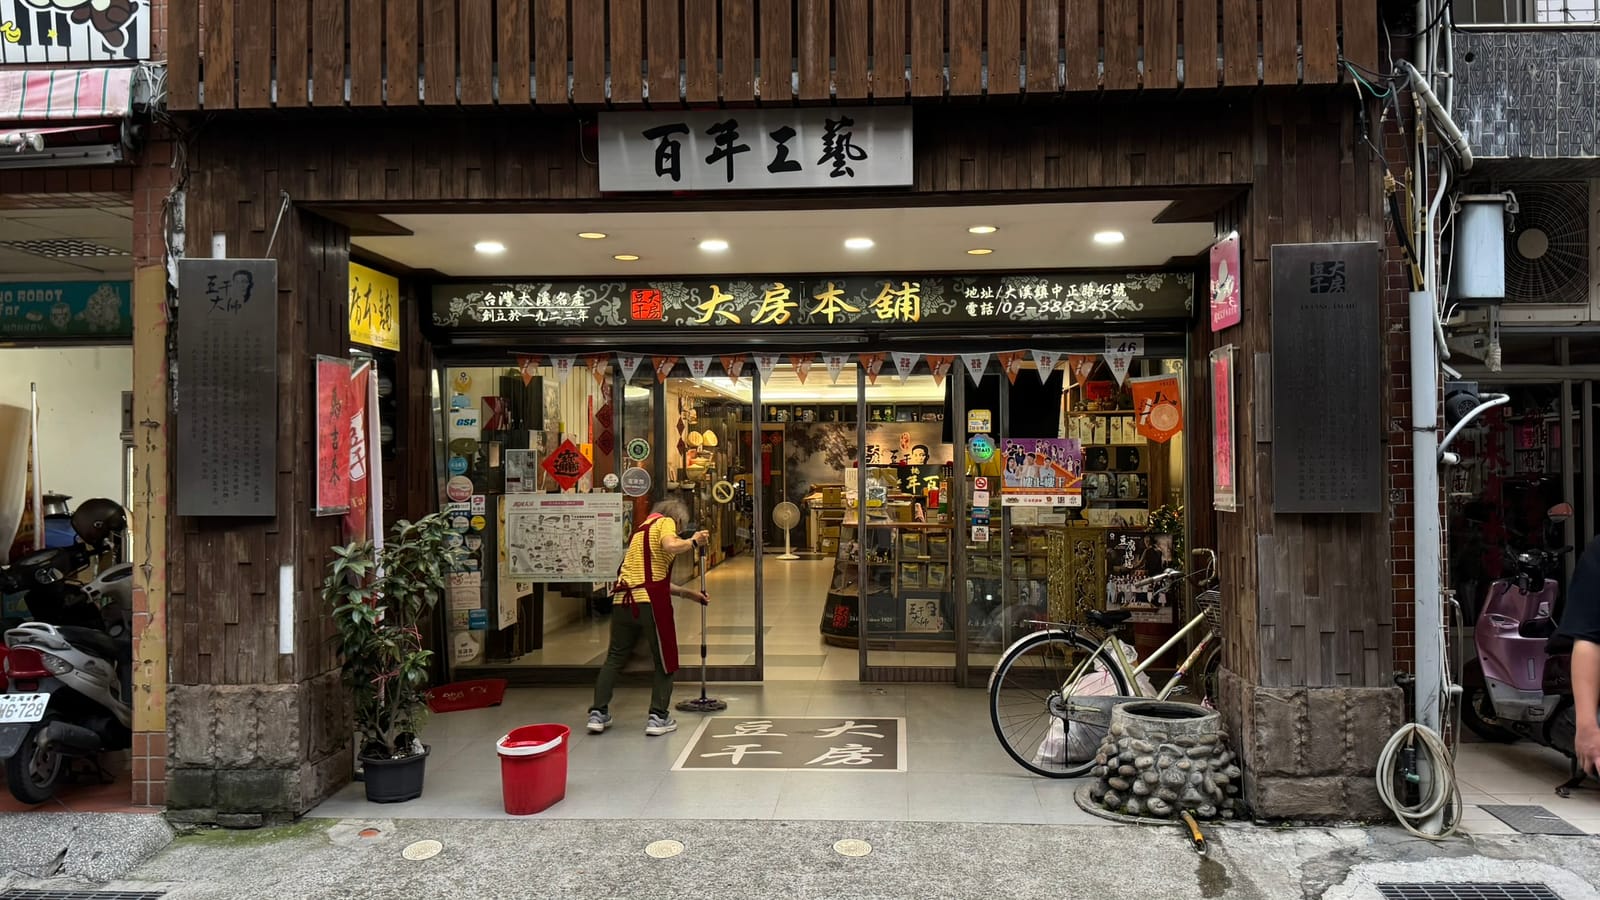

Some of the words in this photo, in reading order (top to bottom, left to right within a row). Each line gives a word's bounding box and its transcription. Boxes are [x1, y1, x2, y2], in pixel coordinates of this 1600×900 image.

[641, 116, 868, 183] 百年工藝
[17, 288, 63, 303] ROBOT
[483, 290, 586, 306] 台灣大溪名產
[694, 282, 921, 325] 大房本舖
[964, 283, 1127, 300] 地址/大溪鎮中正路46號
[481, 309, 589, 323] 創立於一九二三年
[700, 720, 788, 766] 豆干
[804, 720, 885, 766] 大房
